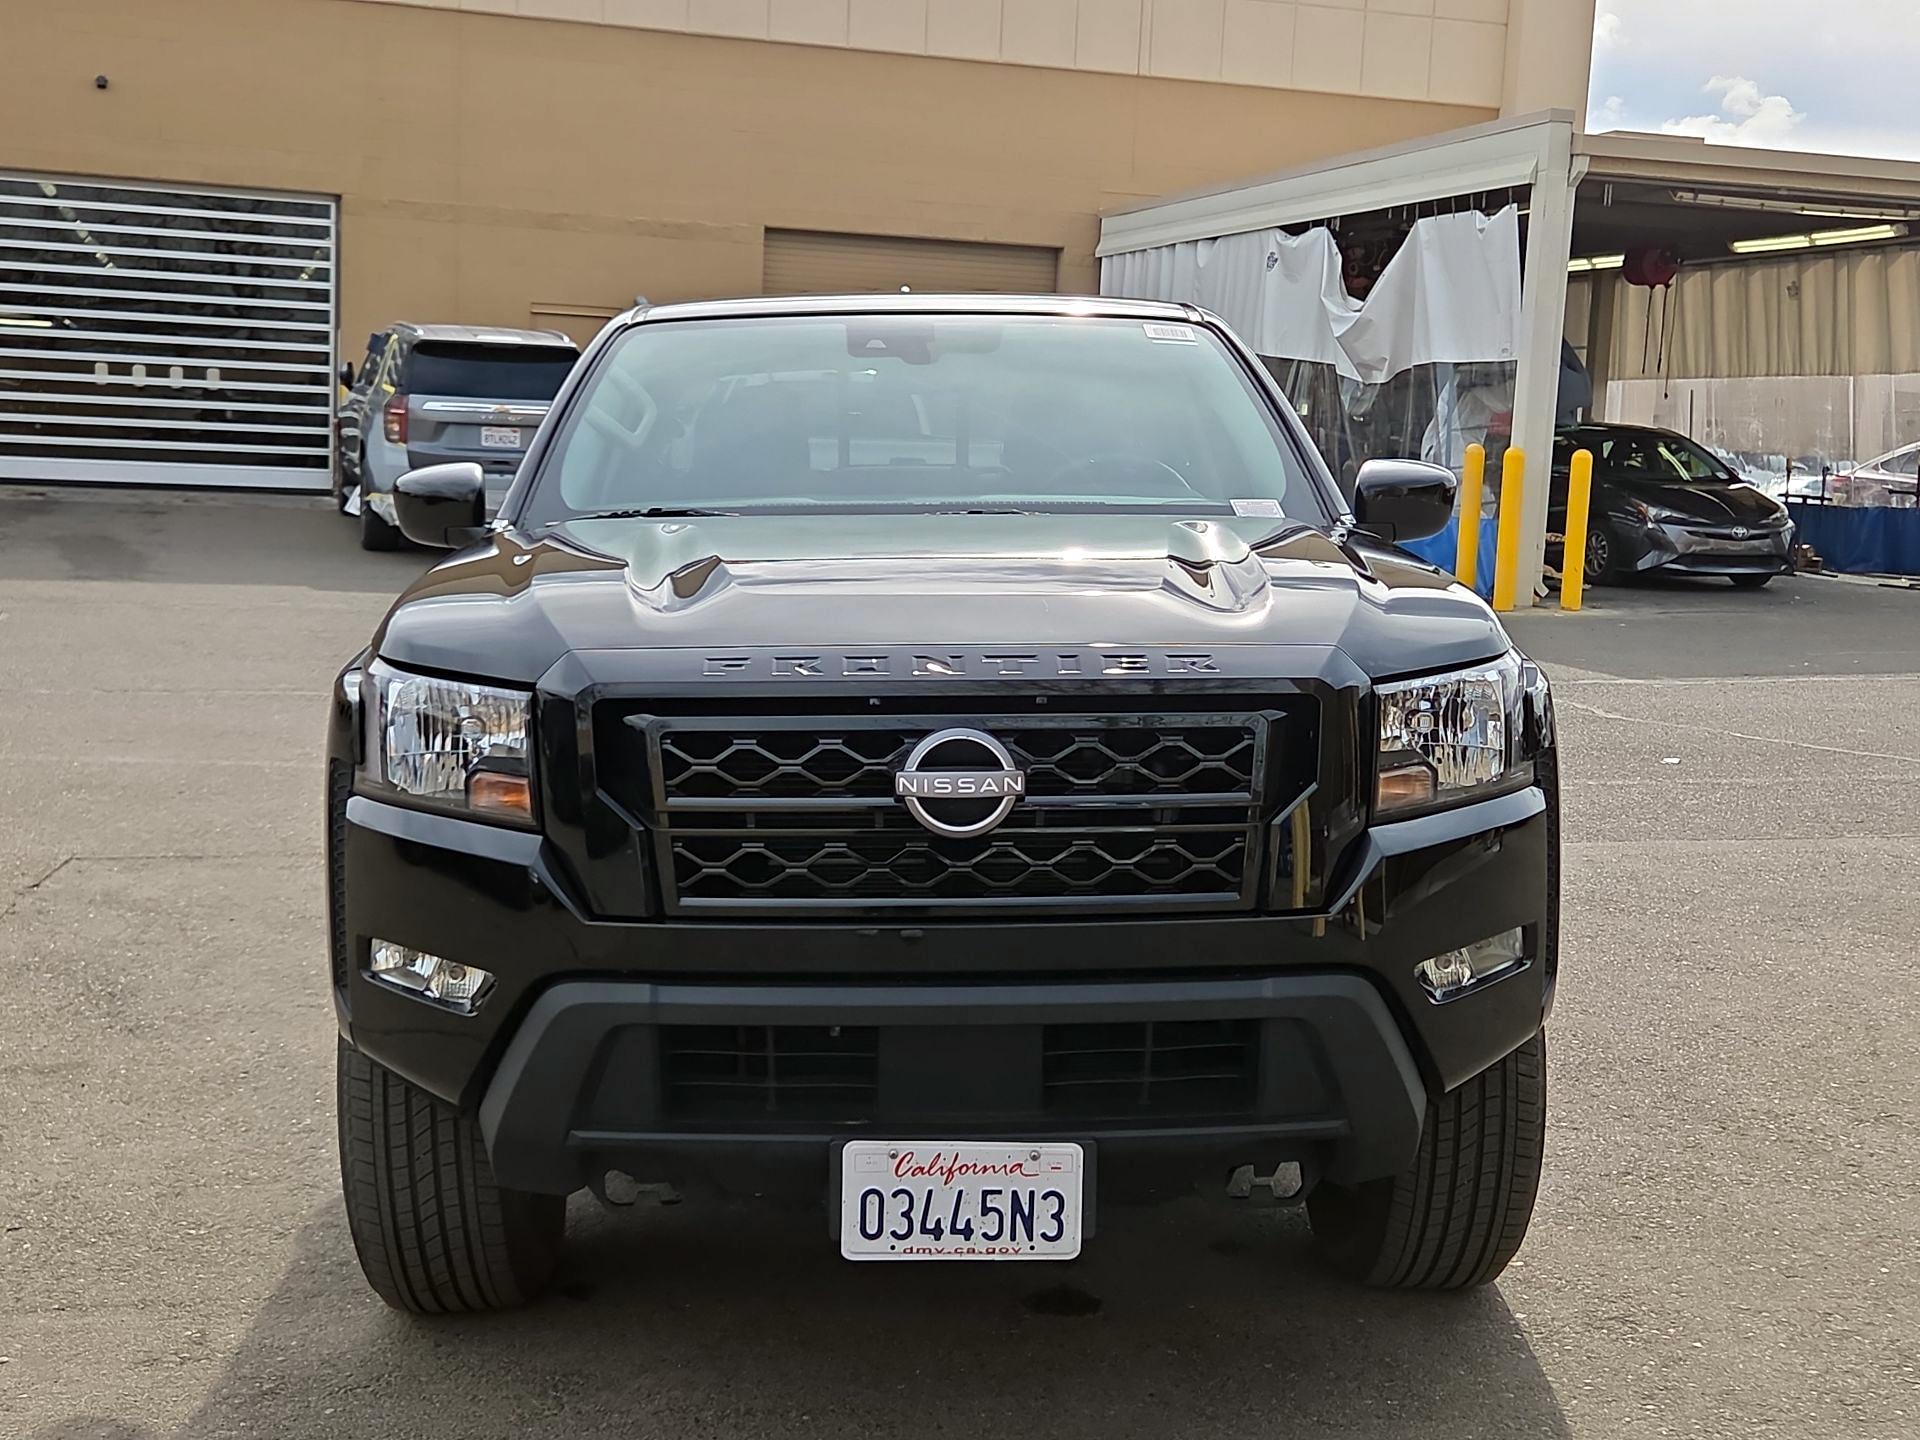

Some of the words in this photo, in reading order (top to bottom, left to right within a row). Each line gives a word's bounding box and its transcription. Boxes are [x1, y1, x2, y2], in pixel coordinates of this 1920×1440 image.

[702, 654, 1221, 676] FRONTIER
[898, 775, 1023, 795] NISSAN
[894, 1151, 1040, 1186] California
[859, 1187, 1066, 1243] 03445N3
[902, 1245, 1023, 1255] dmv.ca.gov
